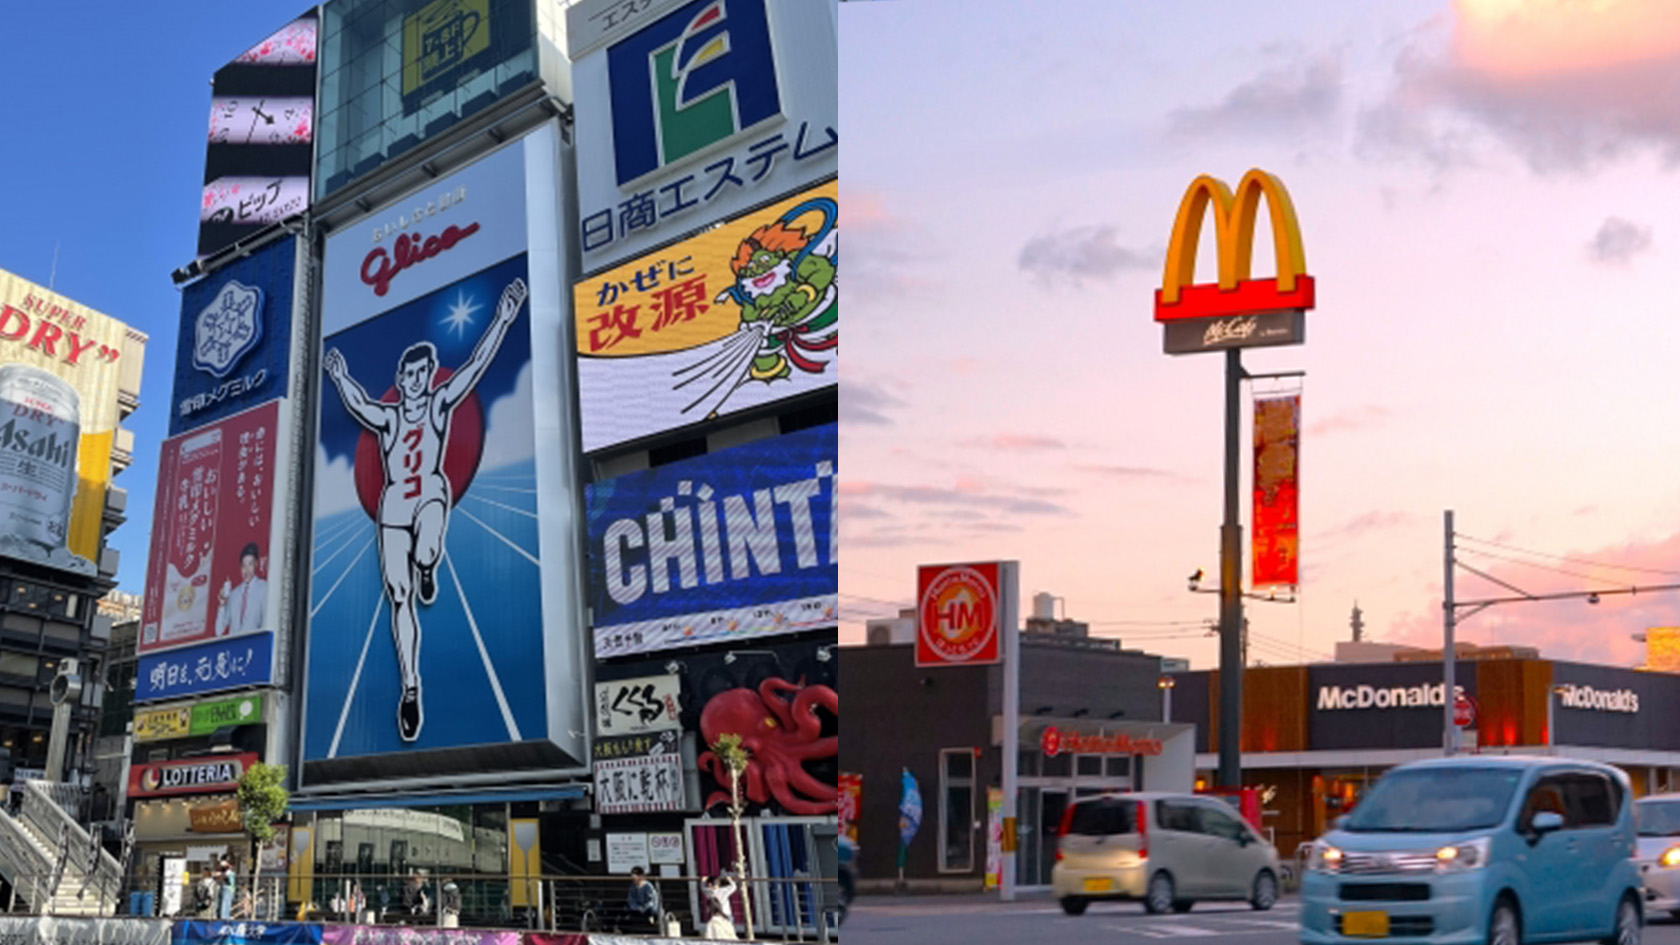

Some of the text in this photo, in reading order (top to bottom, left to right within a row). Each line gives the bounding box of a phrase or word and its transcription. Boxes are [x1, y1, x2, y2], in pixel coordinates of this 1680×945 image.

[582, 121, 838, 252] 日商エステム
[597, 255, 695, 308] かぜに
[24, 292, 86, 332] SUPER
[586, 273, 710, 352] 改源
[0, 418, 70, 468] Asahi
[403, 422, 426, 500] グリコ
[162, 763, 232, 786] LOTTERIA
